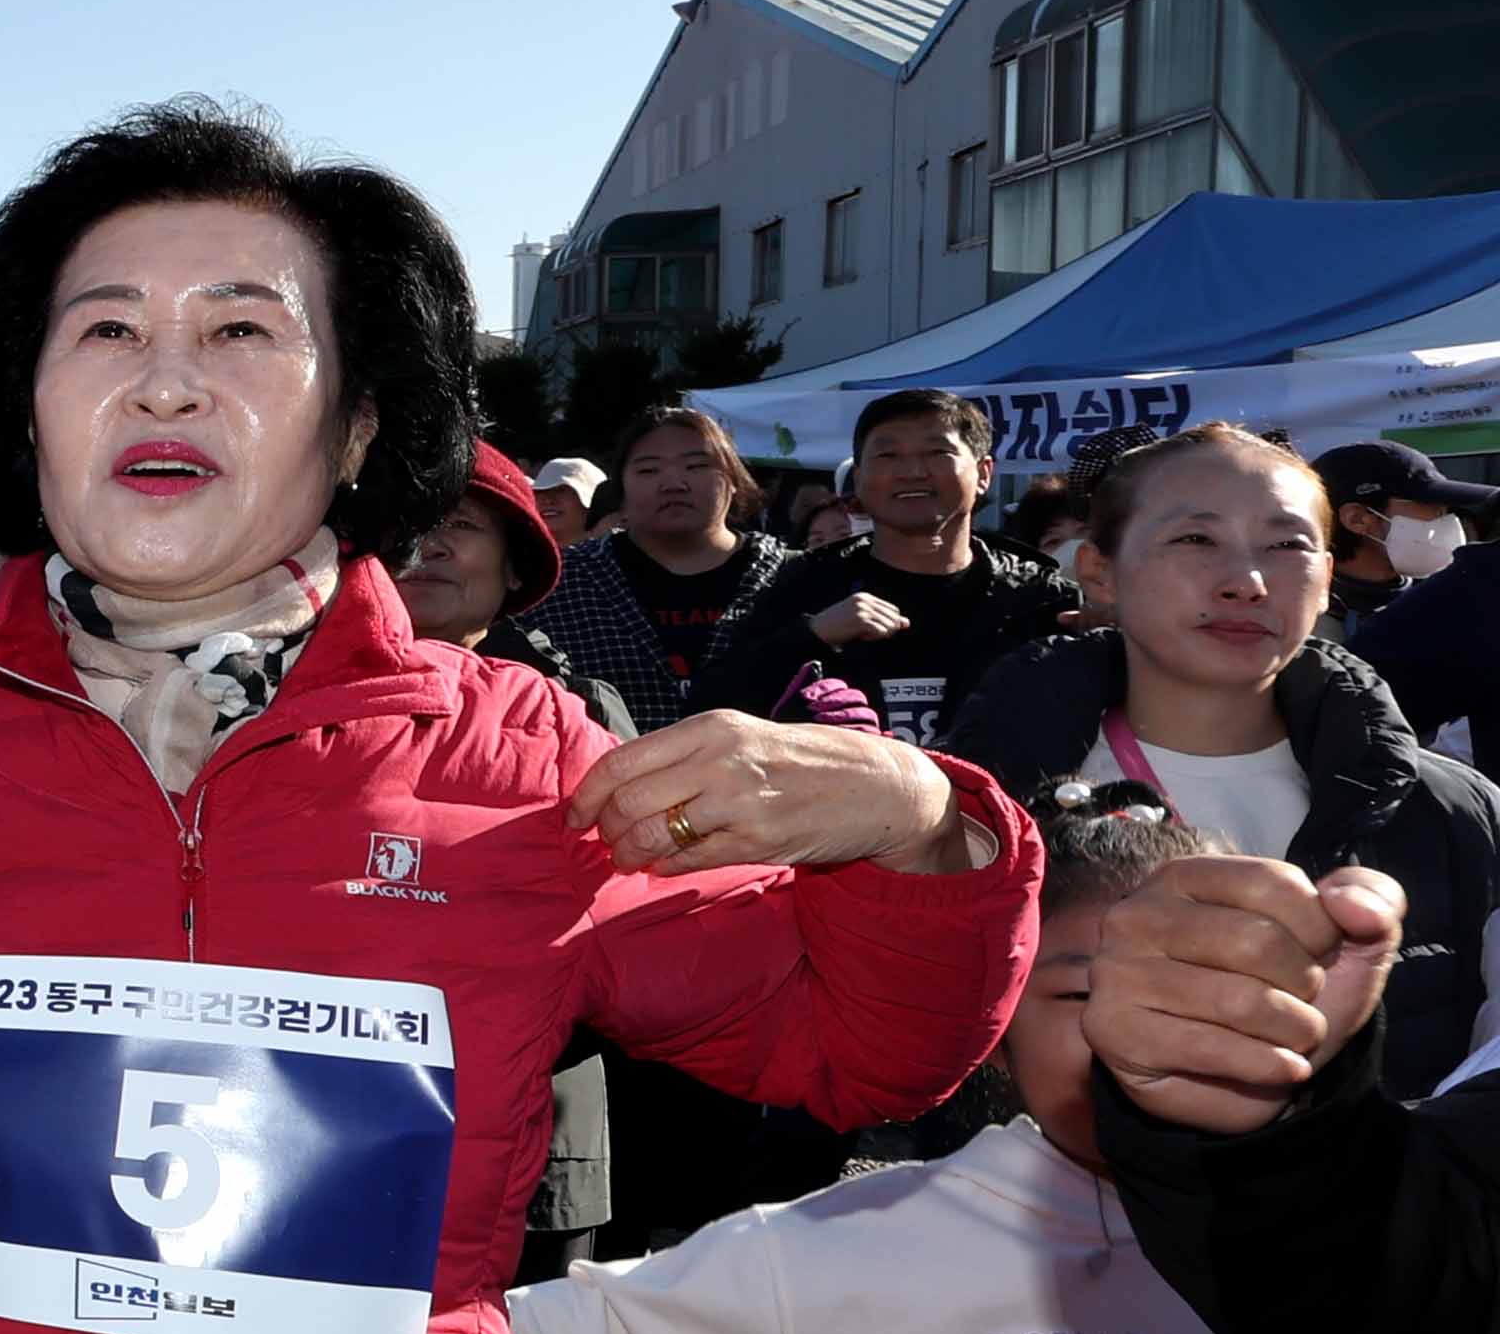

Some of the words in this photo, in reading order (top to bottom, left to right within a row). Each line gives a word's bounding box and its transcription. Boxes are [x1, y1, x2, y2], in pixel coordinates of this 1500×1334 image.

[346, 881, 408, 899] BLACK
[407, 888, 449, 904] YAK
[46, 981, 114, 1017] 동구
[122, 985, 430, 1045] 구민건강걷기대회
[109, 1068, 222, 1231] 5
[89, 1281, 237, 1319] 인천일보
